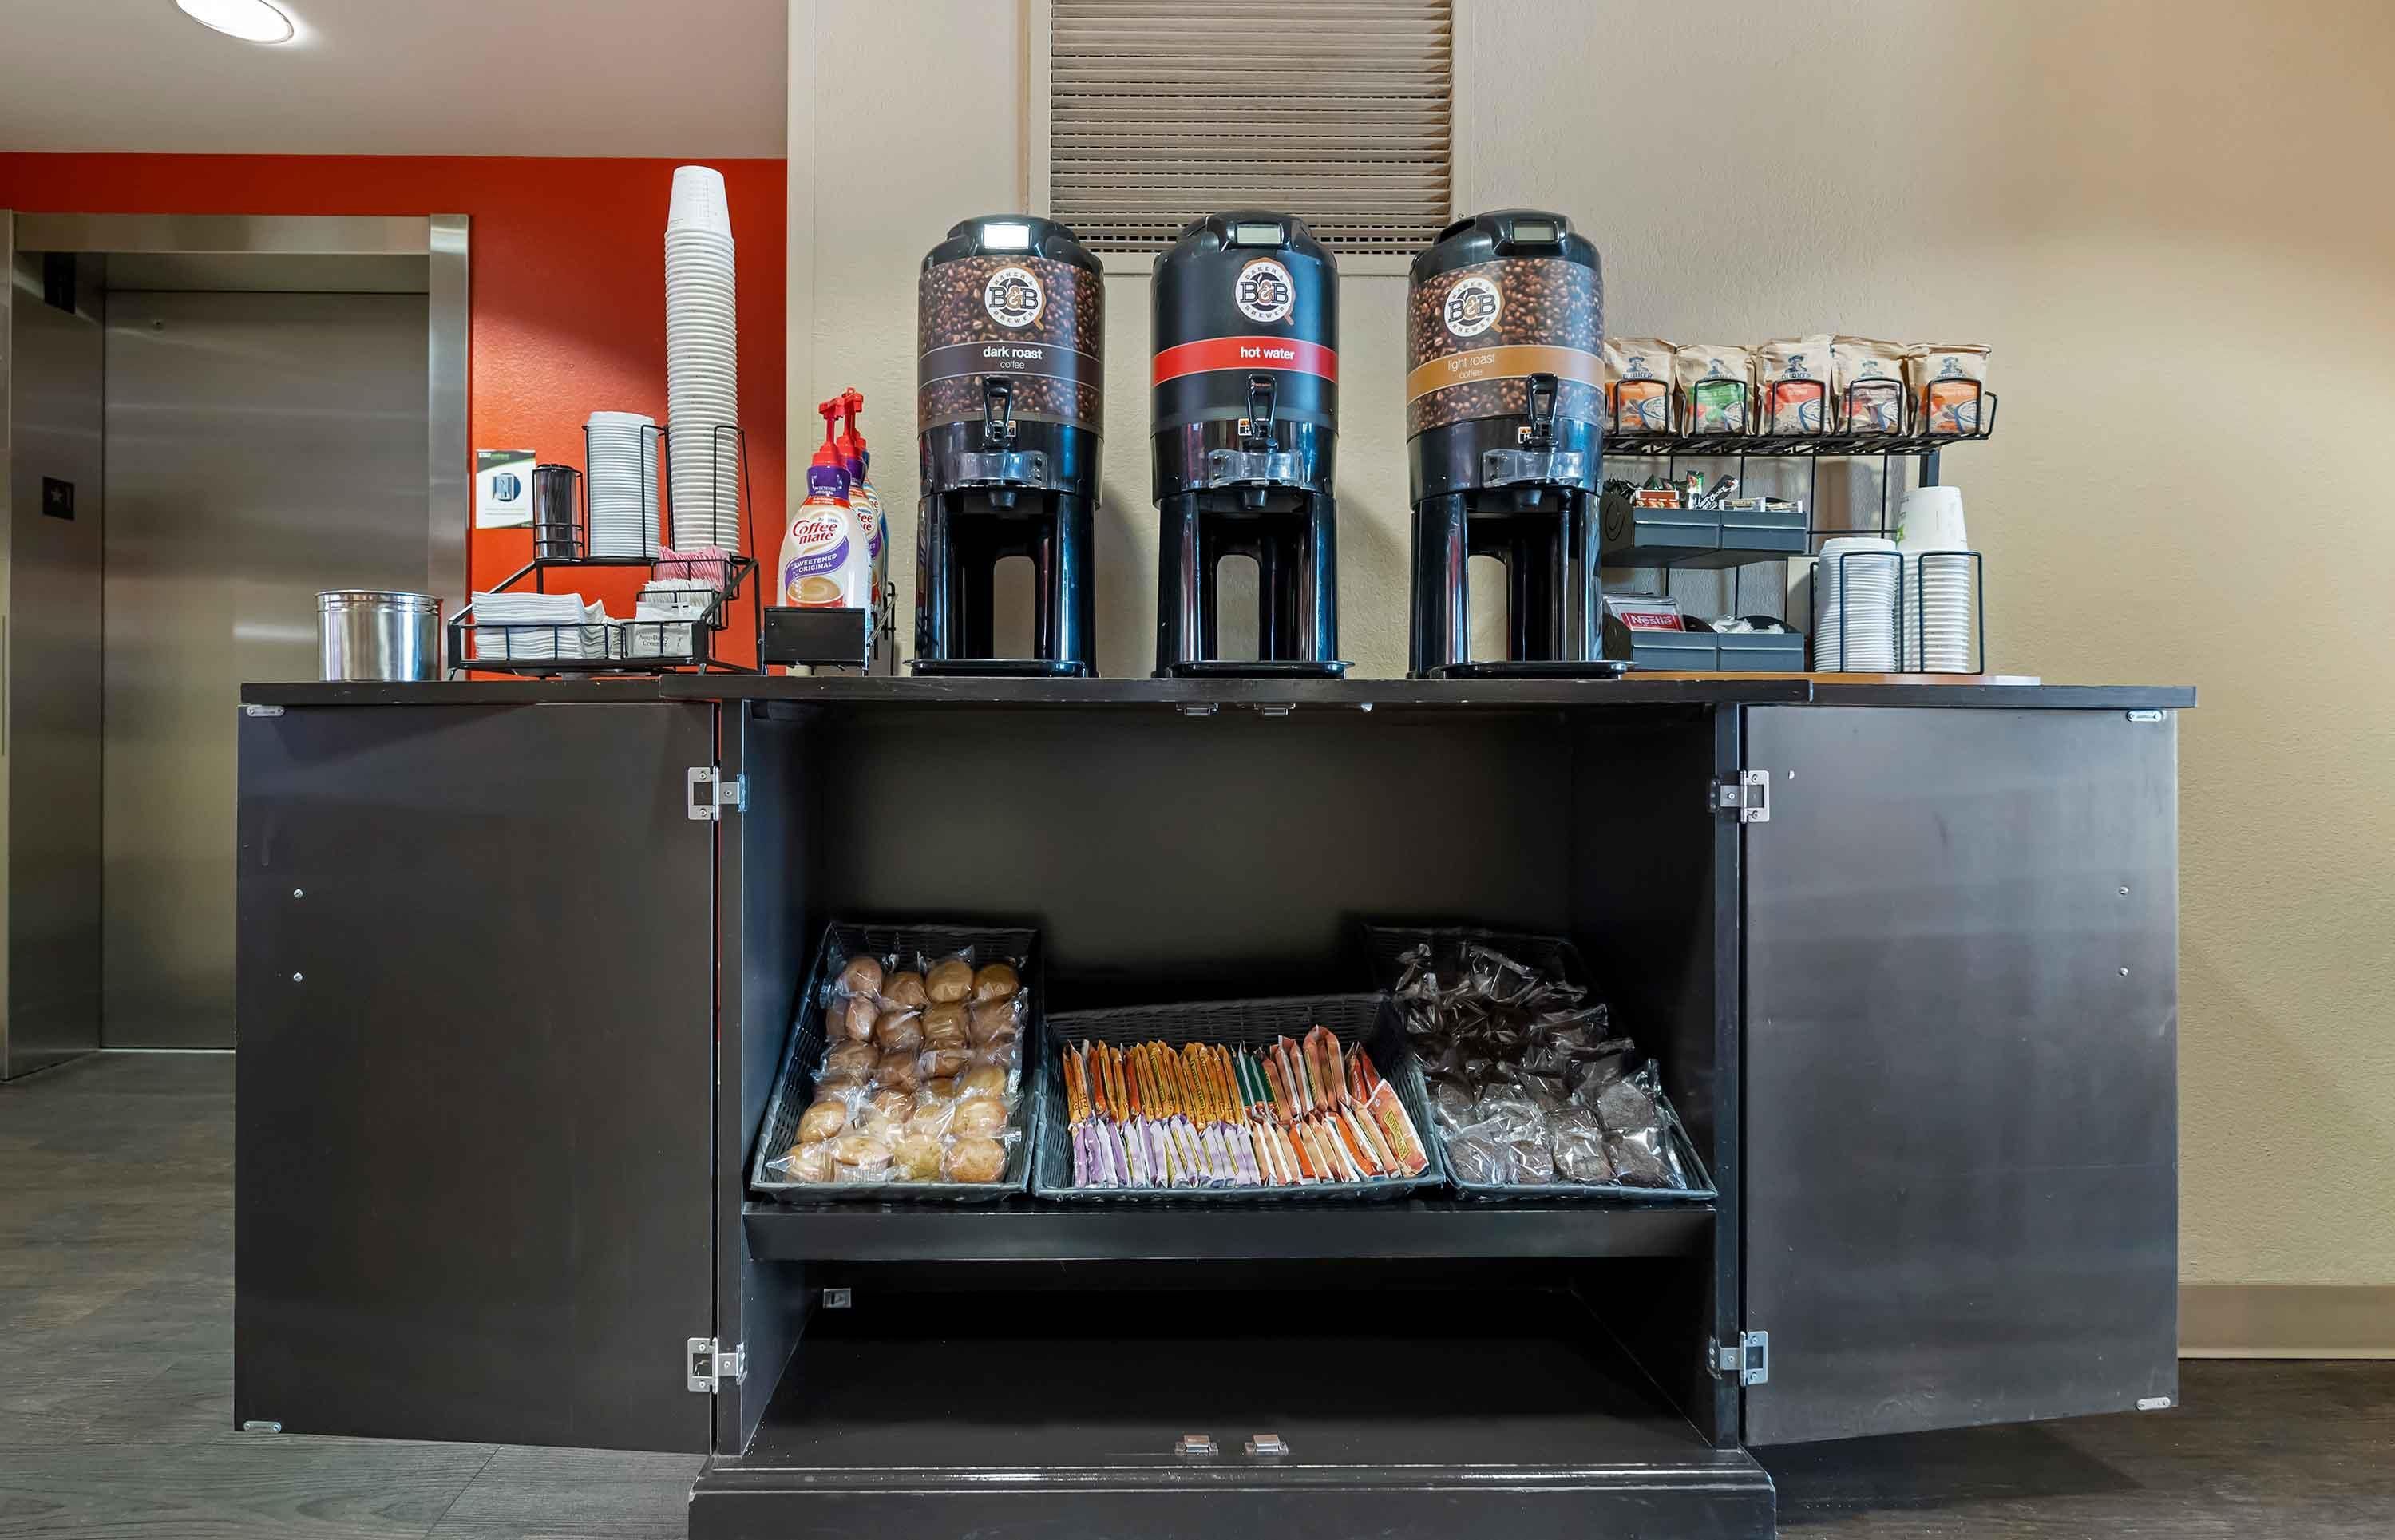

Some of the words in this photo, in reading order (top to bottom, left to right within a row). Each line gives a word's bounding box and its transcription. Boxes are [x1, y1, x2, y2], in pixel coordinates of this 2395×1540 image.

[989, 286, 1039, 310] B&B
[1240, 280, 1289, 304] B&B
[1448, 294, 1496, 323] B&B
[983, 346, 1010, 358] dark
[1011, 348, 1043, 360] roast
[1240, 346, 1261, 358] hot
[1263, 348, 1296, 360] water
[1000, 360, 1025, 369] coffee
[1447, 357, 1467, 372] light
[1469, 352, 1495, 366] roast
[793, 520, 837, 537] Coffee
[799, 532, 833, 544] mate
[798, 562, 832, 573] ORIGINAL
